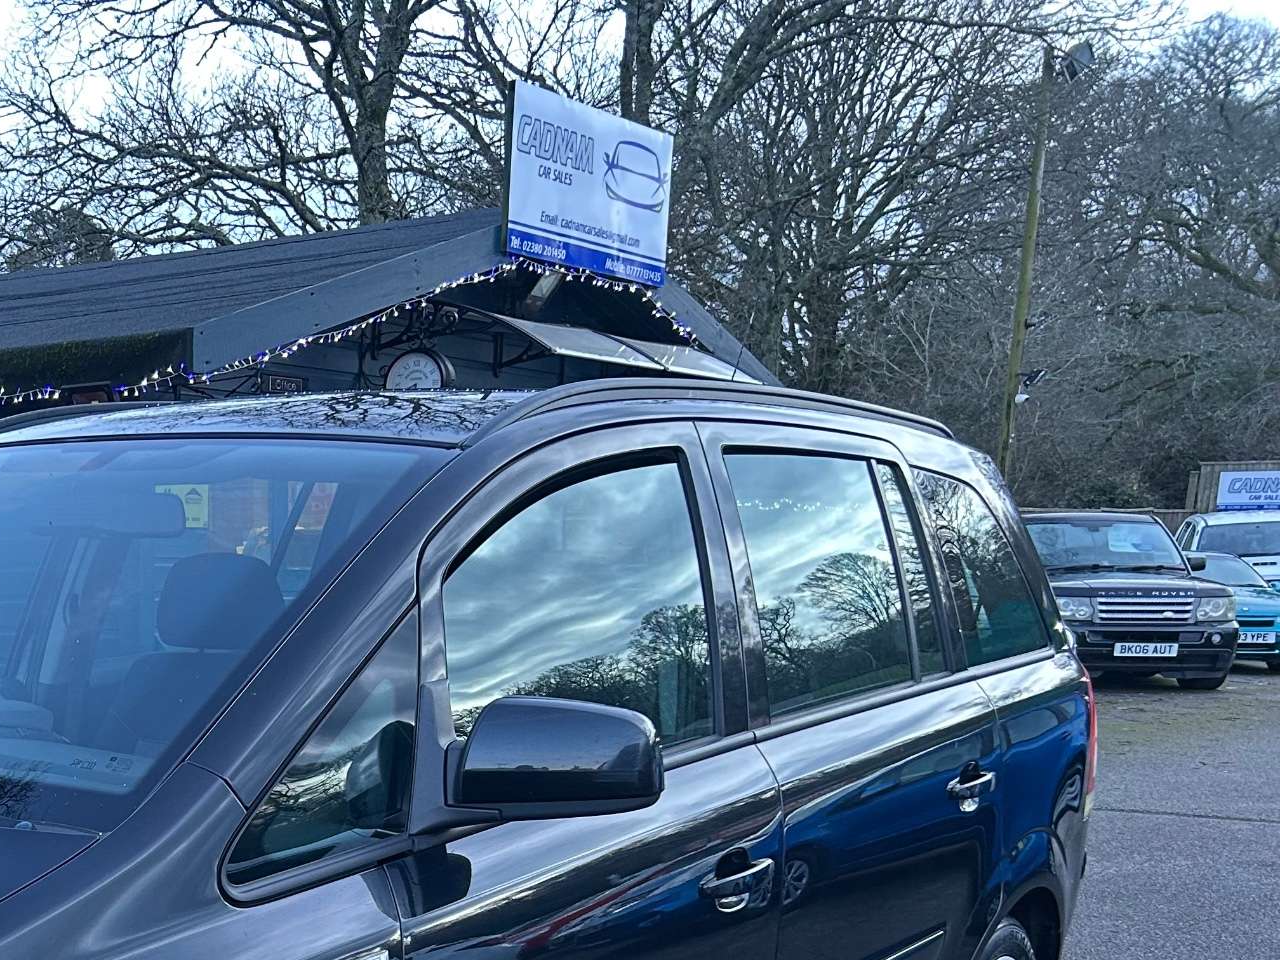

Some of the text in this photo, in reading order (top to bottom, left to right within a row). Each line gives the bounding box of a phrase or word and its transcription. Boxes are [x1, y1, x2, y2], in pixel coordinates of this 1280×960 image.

[517, 114, 594, 174] CADNAM
[538, 164, 573, 186] CAR SALES
[510, 236, 566, 261] Tel: 02380 201450
[1227, 477, 1280, 493] CADN
[1250, 632, 1269, 642] YPE
[1120, 644, 1174, 655] BK06 AUT
